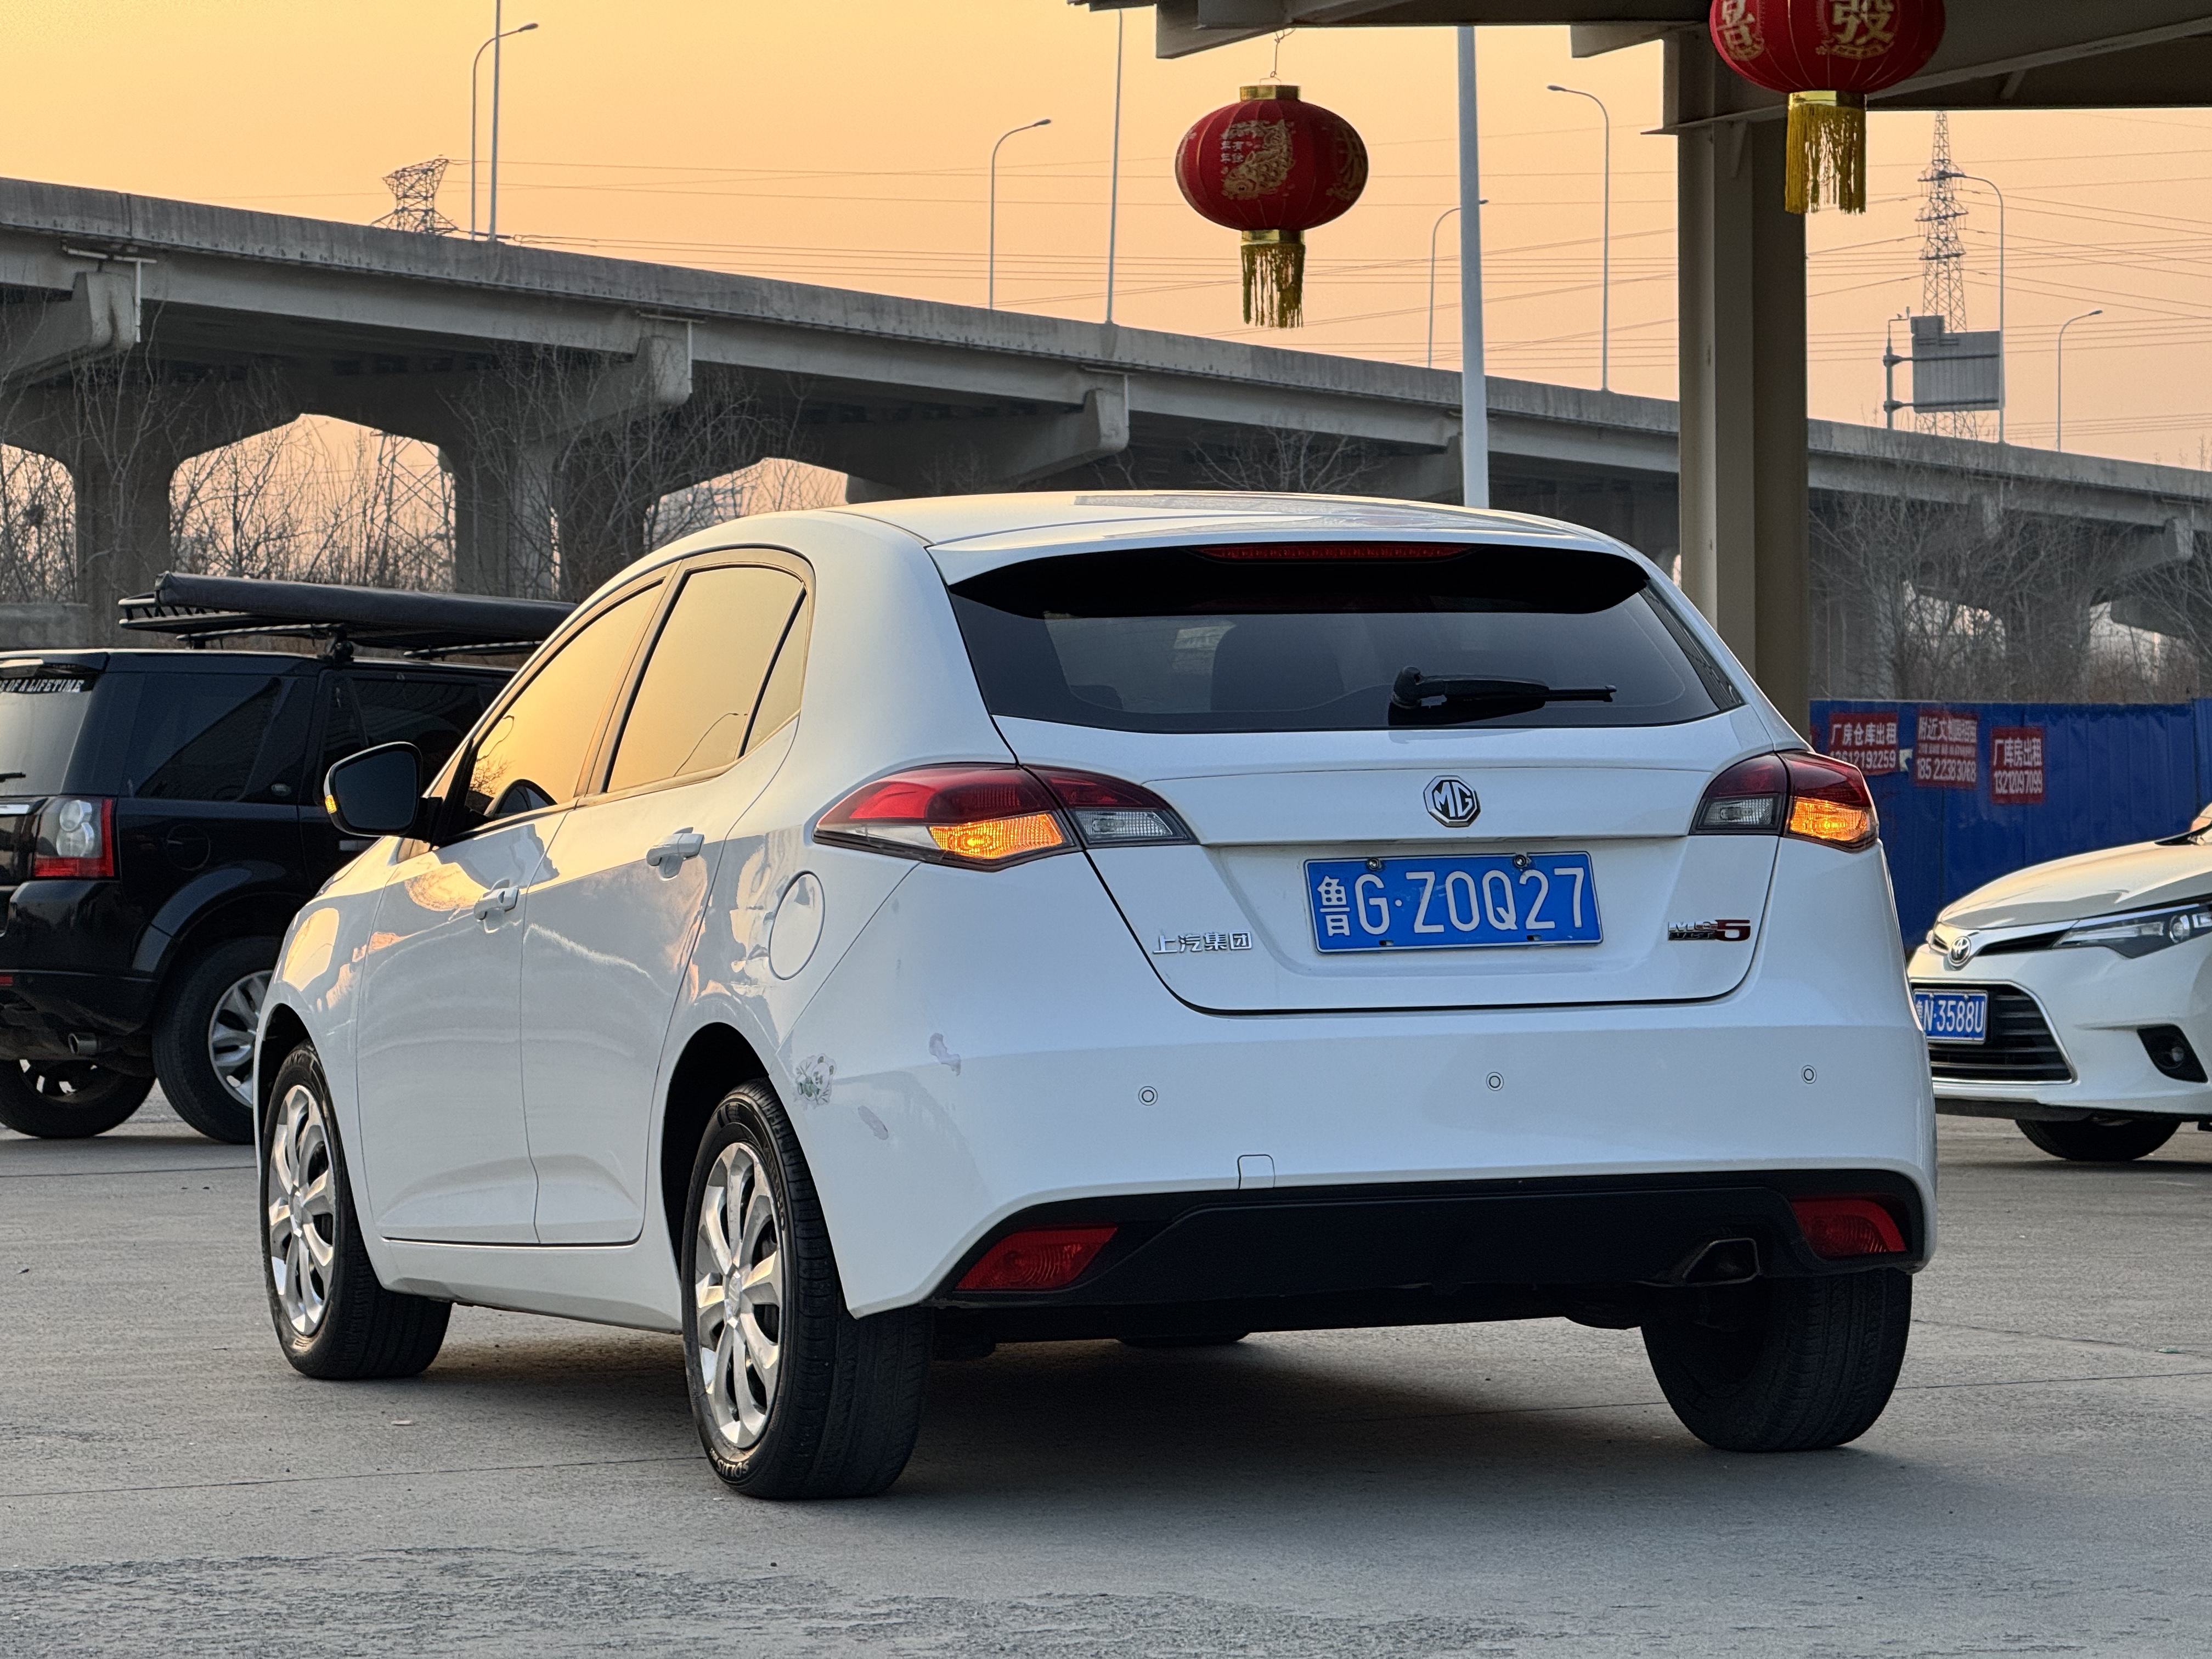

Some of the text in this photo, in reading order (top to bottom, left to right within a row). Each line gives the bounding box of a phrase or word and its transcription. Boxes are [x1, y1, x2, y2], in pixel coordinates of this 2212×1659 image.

[26, 679, 84, 692] LIFETIME
[1831, 722, 1897, 746] 厂房仓库出租
[1993, 737, 2042, 767] 厂库房出租
[1432, 780, 1474, 819] MG
[1153, 931, 1252, 954] 上汽集团
